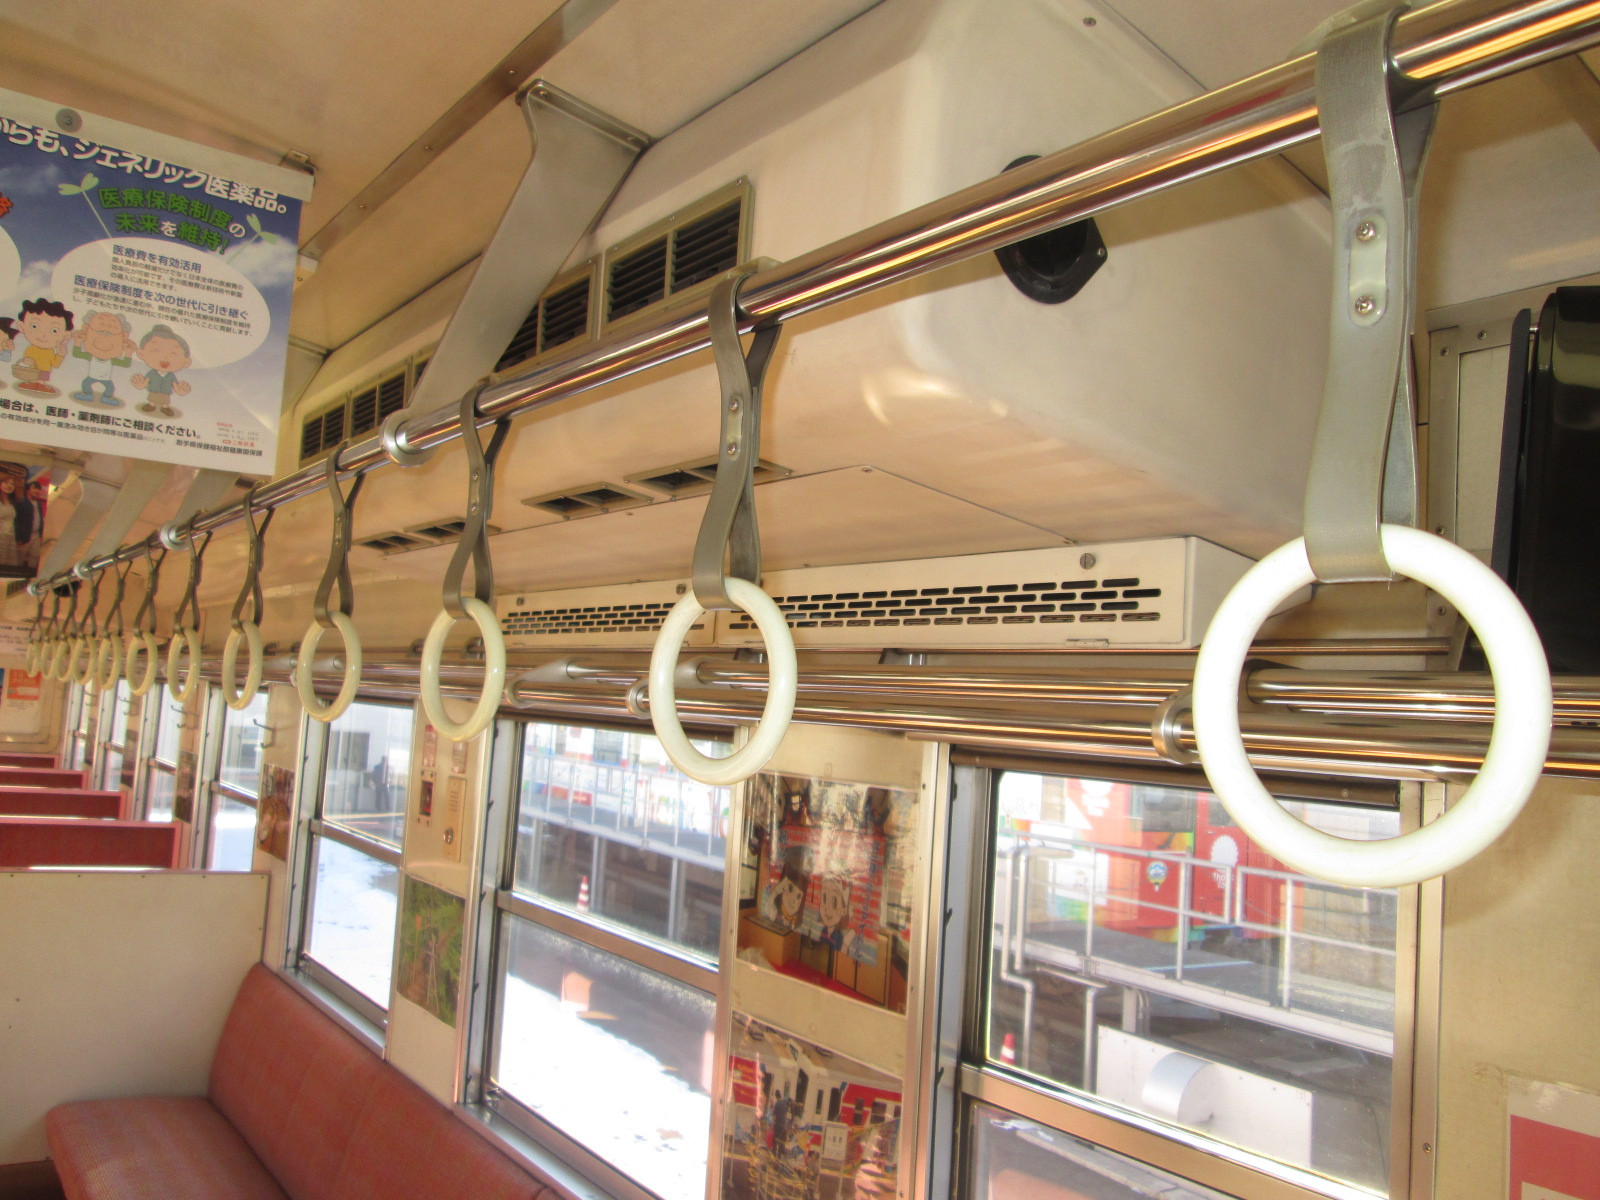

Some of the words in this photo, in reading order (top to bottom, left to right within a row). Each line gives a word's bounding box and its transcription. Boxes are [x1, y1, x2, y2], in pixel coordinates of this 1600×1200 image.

[98, 187, 246, 237] 医療保険制度の
[112, 244, 202, 274] 医療費を有効活用
[74, 275, 249, 320] 医療保険制度を次の世代に引き継ぐ
